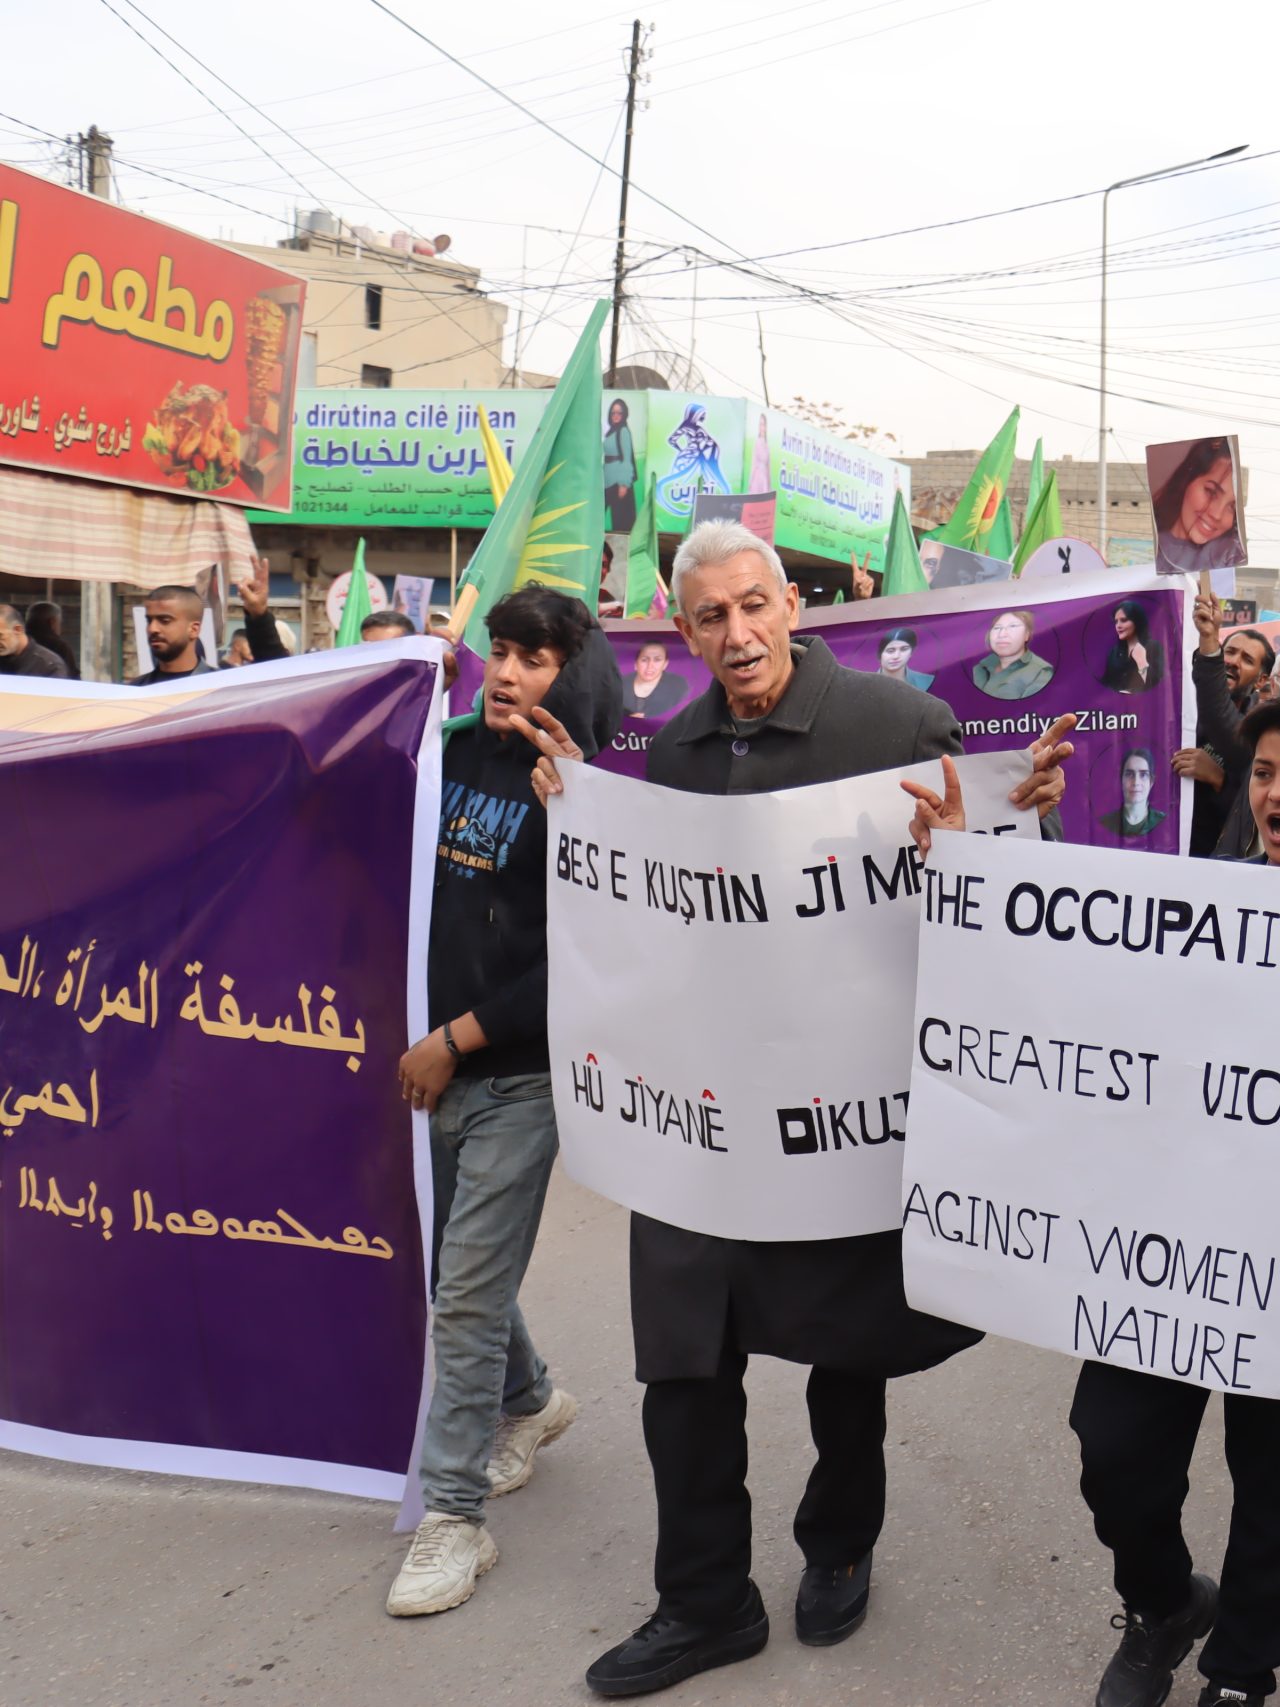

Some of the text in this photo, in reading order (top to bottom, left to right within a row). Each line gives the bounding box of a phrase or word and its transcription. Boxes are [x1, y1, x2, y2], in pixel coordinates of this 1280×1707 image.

[41, 253, 234, 361] مطعم
[53, 406, 94, 452] مشوي
[96, 417, 131, 457] فروج
[303, 437, 420, 474] للخياطة
[307, 404, 397, 428] dirûtina
[406, 404, 448, 428] cilê
[611, 731, 653, 750] Cûr
[1075, 711, 1138, 731] Zilam
[557, 832, 599, 891] BES
[610, 850, 628, 901] E
[644, 858, 769, 925] KUŞTİN
[795, 855, 846, 918] Jİ
[924, 867, 985, 932] THE
[55, 938, 159, 1034] المرأة
[179, 960, 366, 1073] بفلسفة
[571, 1053, 605, 1113] HÛ
[620, 1076, 728, 1153] JİYANÊ
[918, 1016, 1160, 1106] GREATEST
[1078, 1218, 1275, 1311] WOMEN
[1073, 1294, 1257, 1390] NATURE
